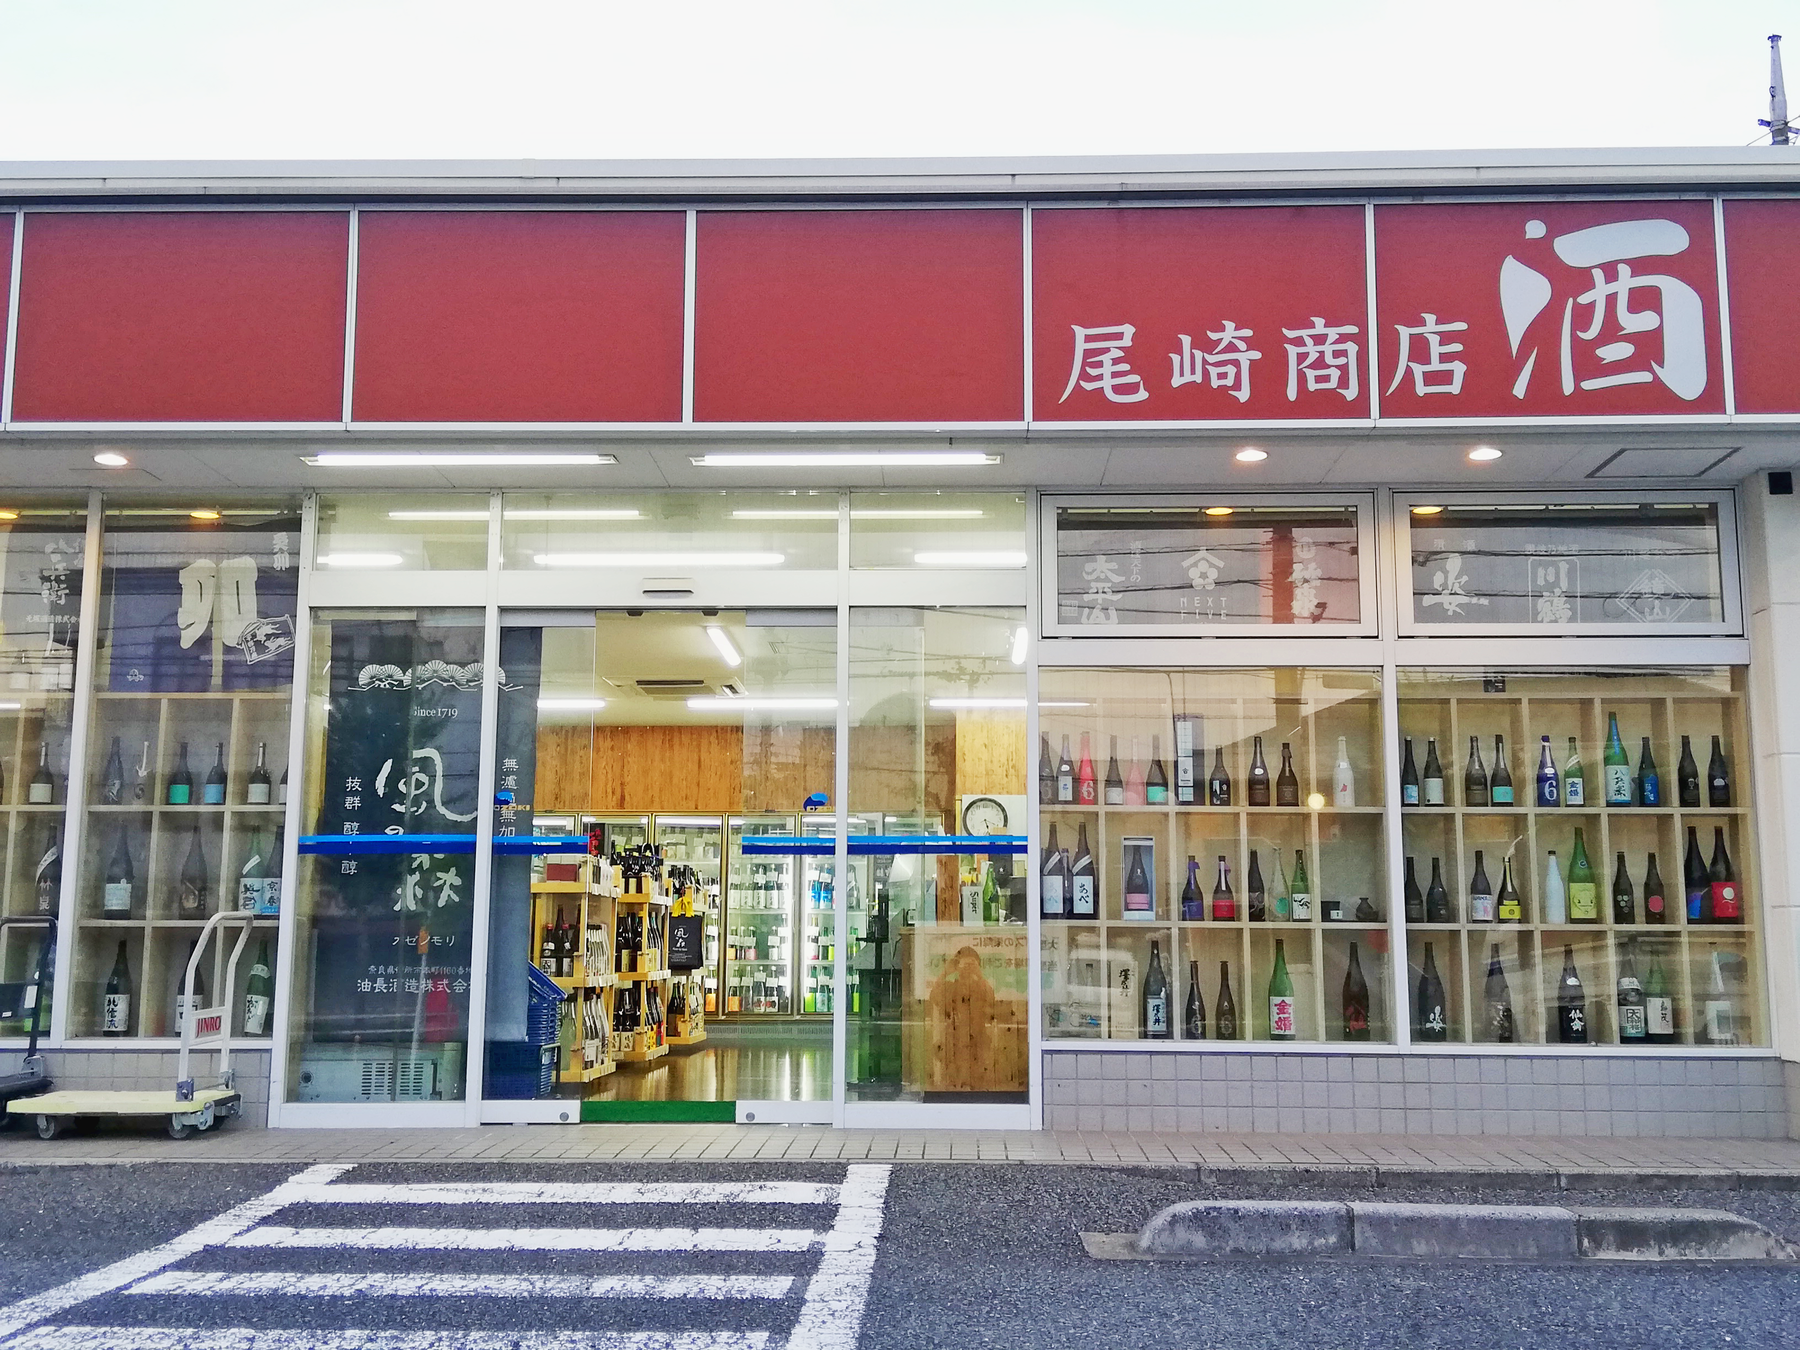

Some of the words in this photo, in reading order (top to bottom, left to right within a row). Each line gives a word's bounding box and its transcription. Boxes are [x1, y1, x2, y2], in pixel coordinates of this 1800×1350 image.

[1500, 219, 1708, 402] 酒
[1059, 313, 1467, 404] 尾崎商店
[1081, 555, 1126, 624] 太平山
[1180, 596, 1227, 608] NEXT
[1180, 609, 1227, 620] FIVE
[438, 708, 458, 719] 1719
[1082, 780, 1095, 800] 6
[1544, 780, 1557, 800] 6
[968, 890, 979, 915] Super
[357, 978, 472, 993] 油長酒造株式会
[195, 1014, 222, 1038] JINRO
